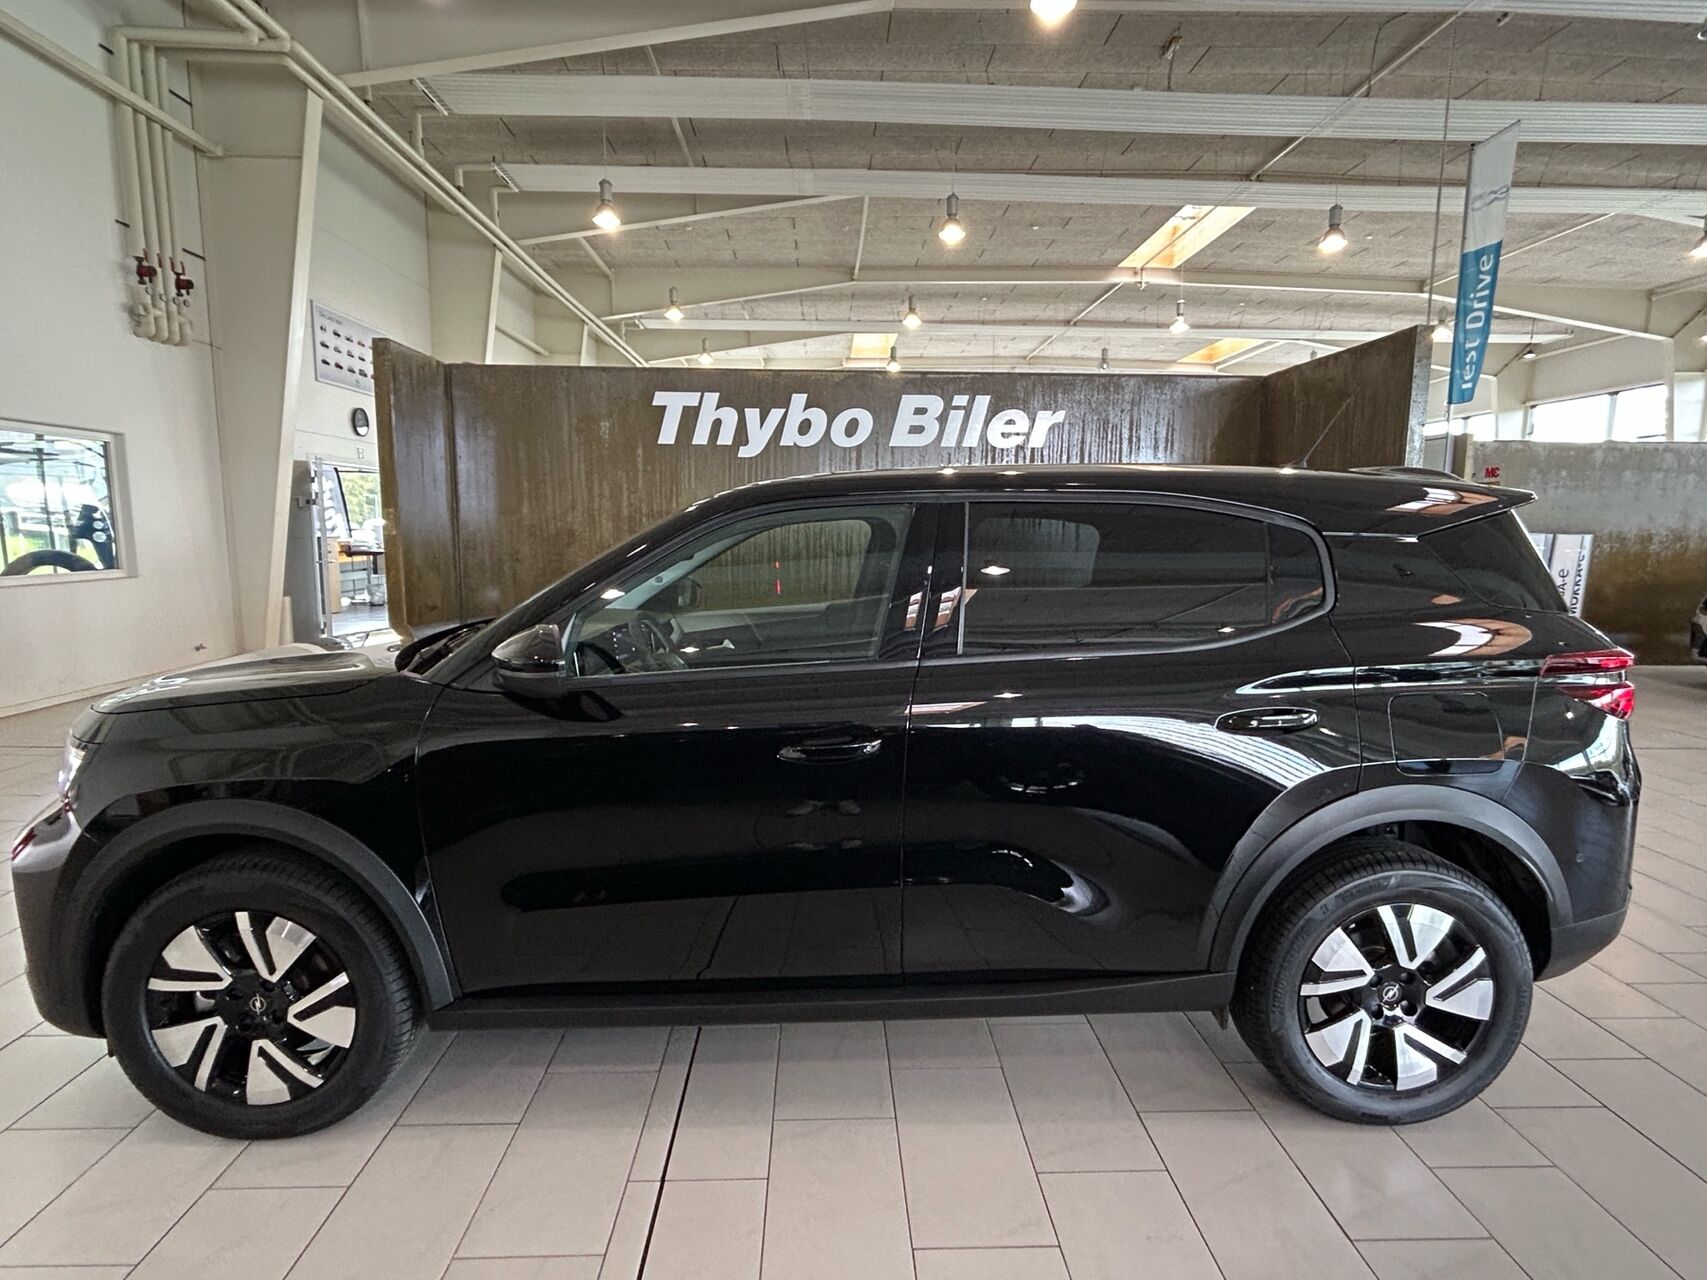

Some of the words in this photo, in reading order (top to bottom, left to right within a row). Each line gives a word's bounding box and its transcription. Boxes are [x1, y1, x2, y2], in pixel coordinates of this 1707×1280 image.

[1466, 253, 1494, 329] Drive
[652, 391, 874, 458] Thybo
[889, 394, 1066, 448] Biler
